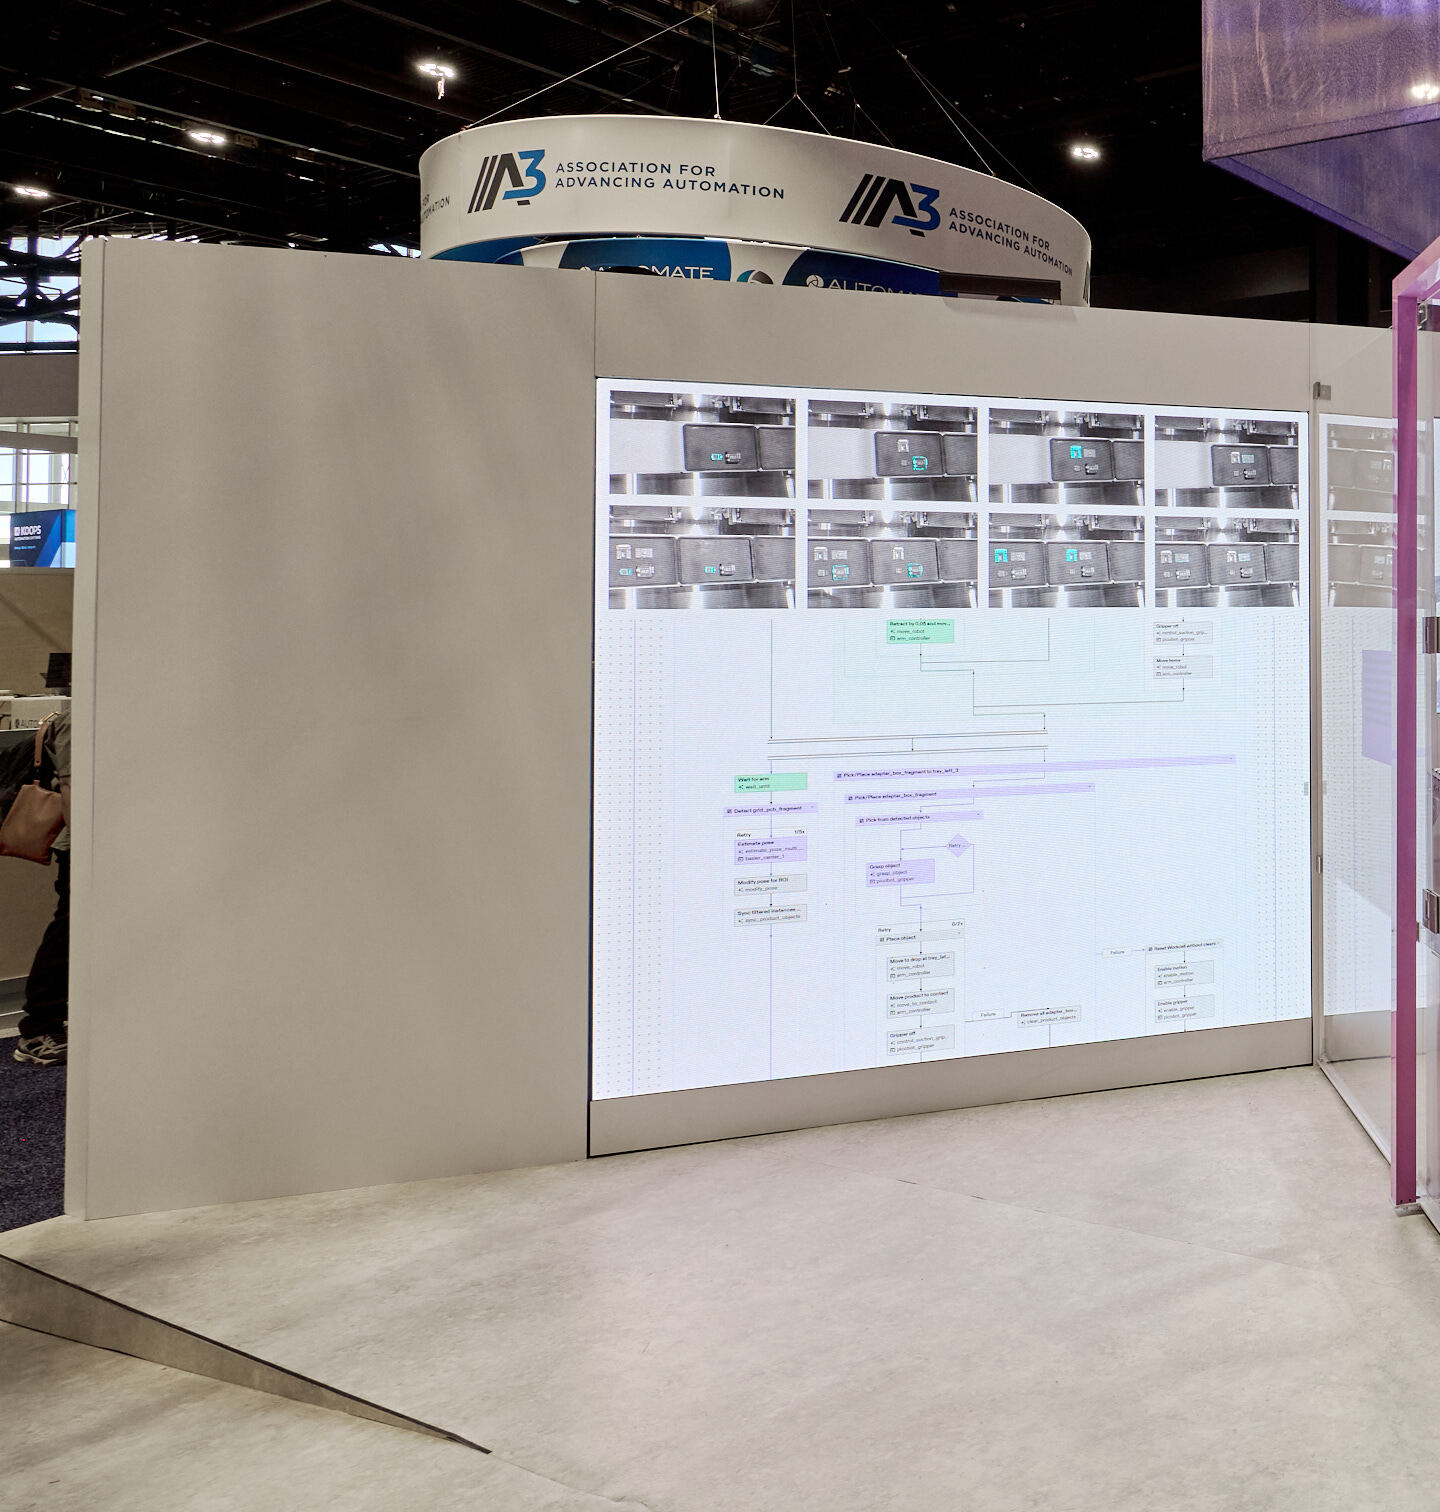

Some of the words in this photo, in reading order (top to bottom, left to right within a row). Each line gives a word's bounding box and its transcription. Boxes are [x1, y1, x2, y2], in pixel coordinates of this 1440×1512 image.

[555, 161, 670, 174] ASSOCIATION
[679, 164, 715, 177] FOR
[555, 176, 655, 189] ADVANCING
[662, 179, 784, 199] AUTOMATION
[949, 207, 1029, 241] ASSOCIATION
[1032, 235, 1050, 251] FOR
[949, 221, 1020, 251] ADVANCING
[1023, 245, 1073, 276] AUTOMATION
[21, 525, 42, 536] KOOPS
